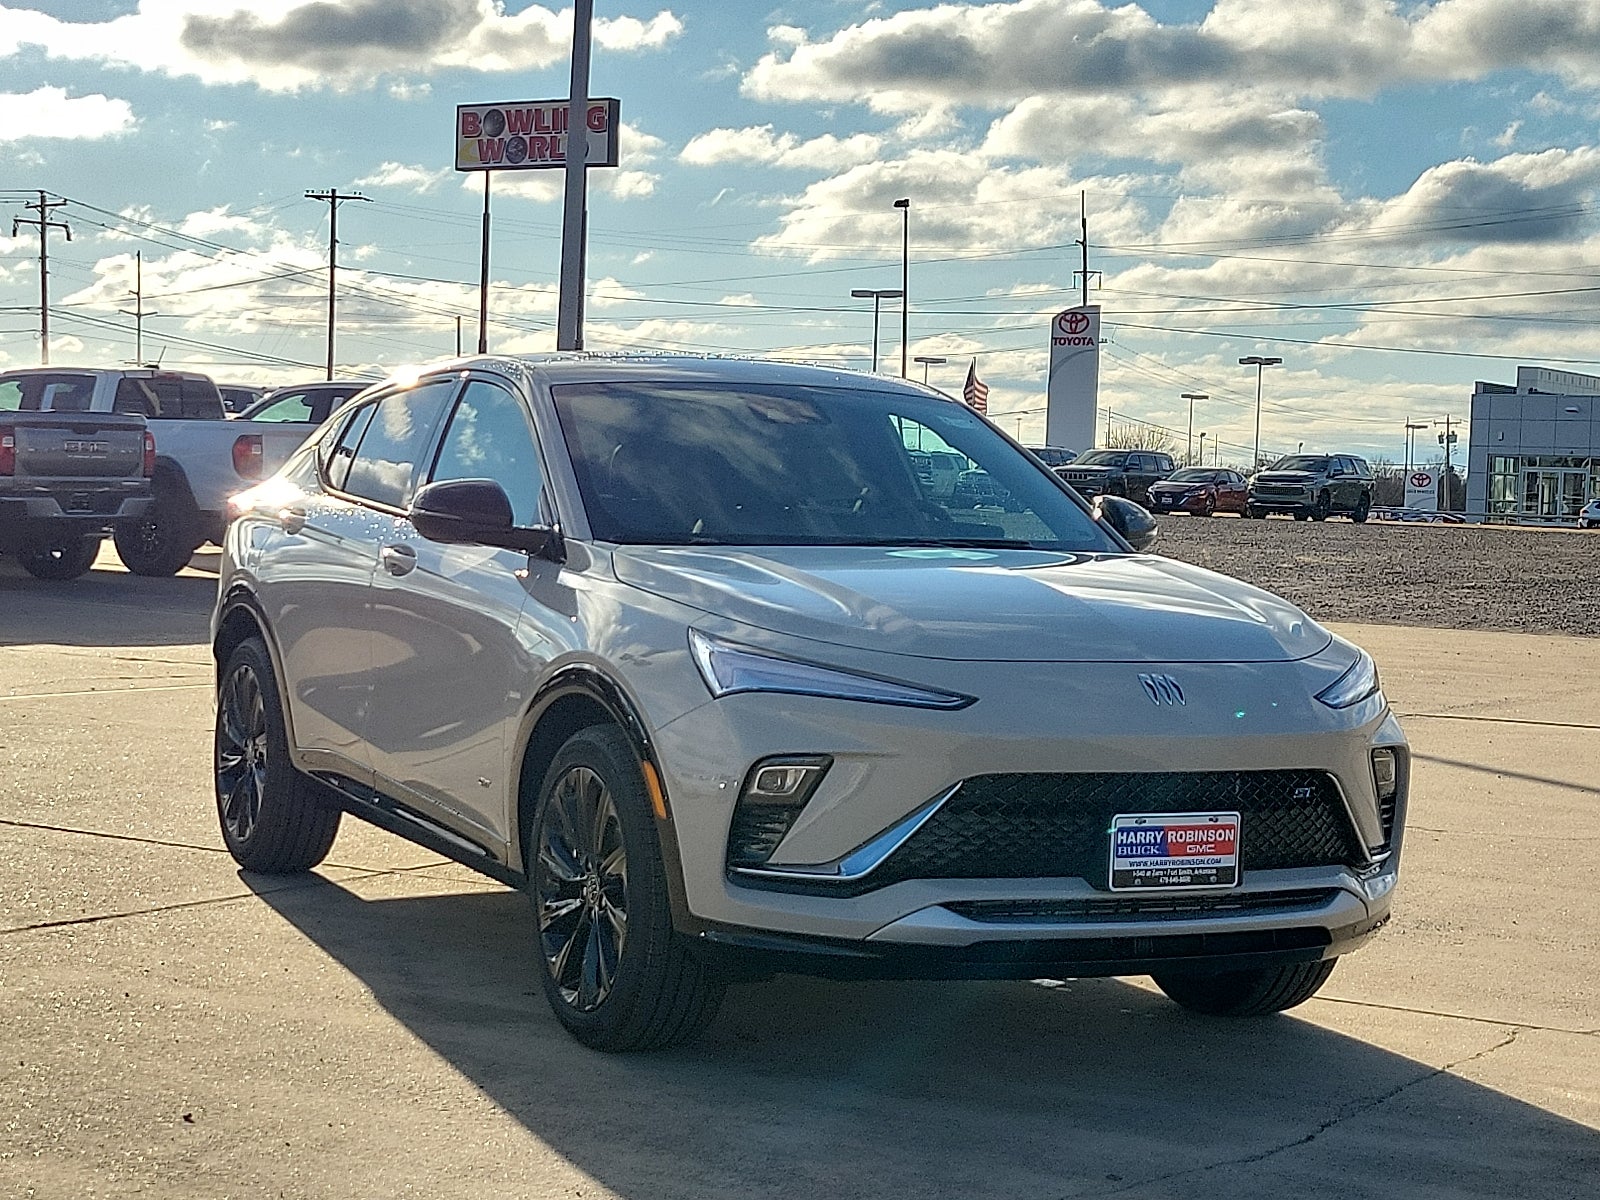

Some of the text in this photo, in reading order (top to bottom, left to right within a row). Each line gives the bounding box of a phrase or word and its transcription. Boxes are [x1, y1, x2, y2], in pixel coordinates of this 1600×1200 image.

[462, 105, 607, 138] BOWLIG
[477, 136, 589, 164] WORL
[1053, 337, 1094, 346] TOYOTA
[1117, 828, 1234, 844] HARRY ROBINSON
[1117, 844, 1216, 855] BUICK GMC
